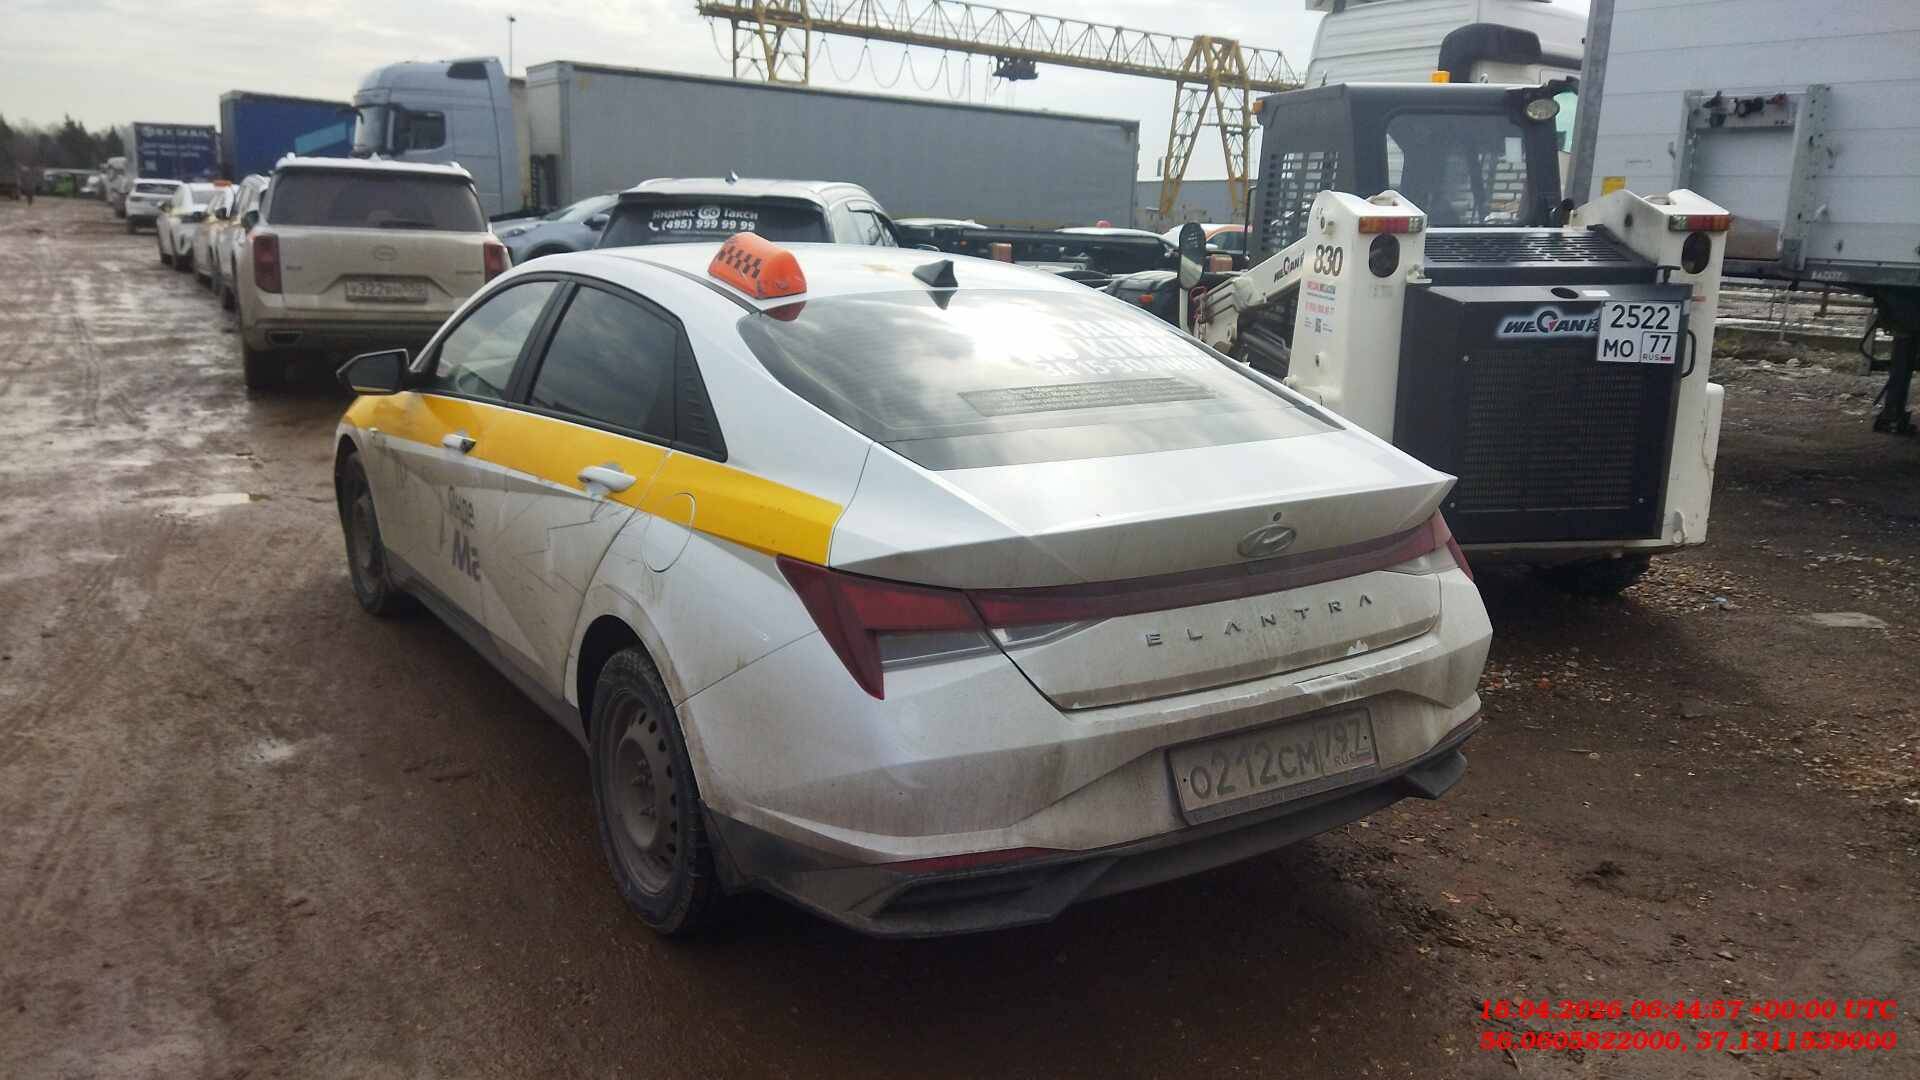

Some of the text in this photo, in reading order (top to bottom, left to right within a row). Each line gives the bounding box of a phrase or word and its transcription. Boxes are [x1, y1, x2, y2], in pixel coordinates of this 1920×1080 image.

[652, 208, 696, 220] Яндекс
[724, 209, 759, 220] Такси
[662, 219, 756, 231] (495) 999 99 99
[1314, 244, 1344, 277] 830
[1610, 304, 1671, 330] 2522
[1603, 338, 1634, 358] МО
[1649, 335, 1672, 353] 77
[1144, 594, 1373, 647] ELANTRA
[1189, 737, 1320, 800] О212СМ
